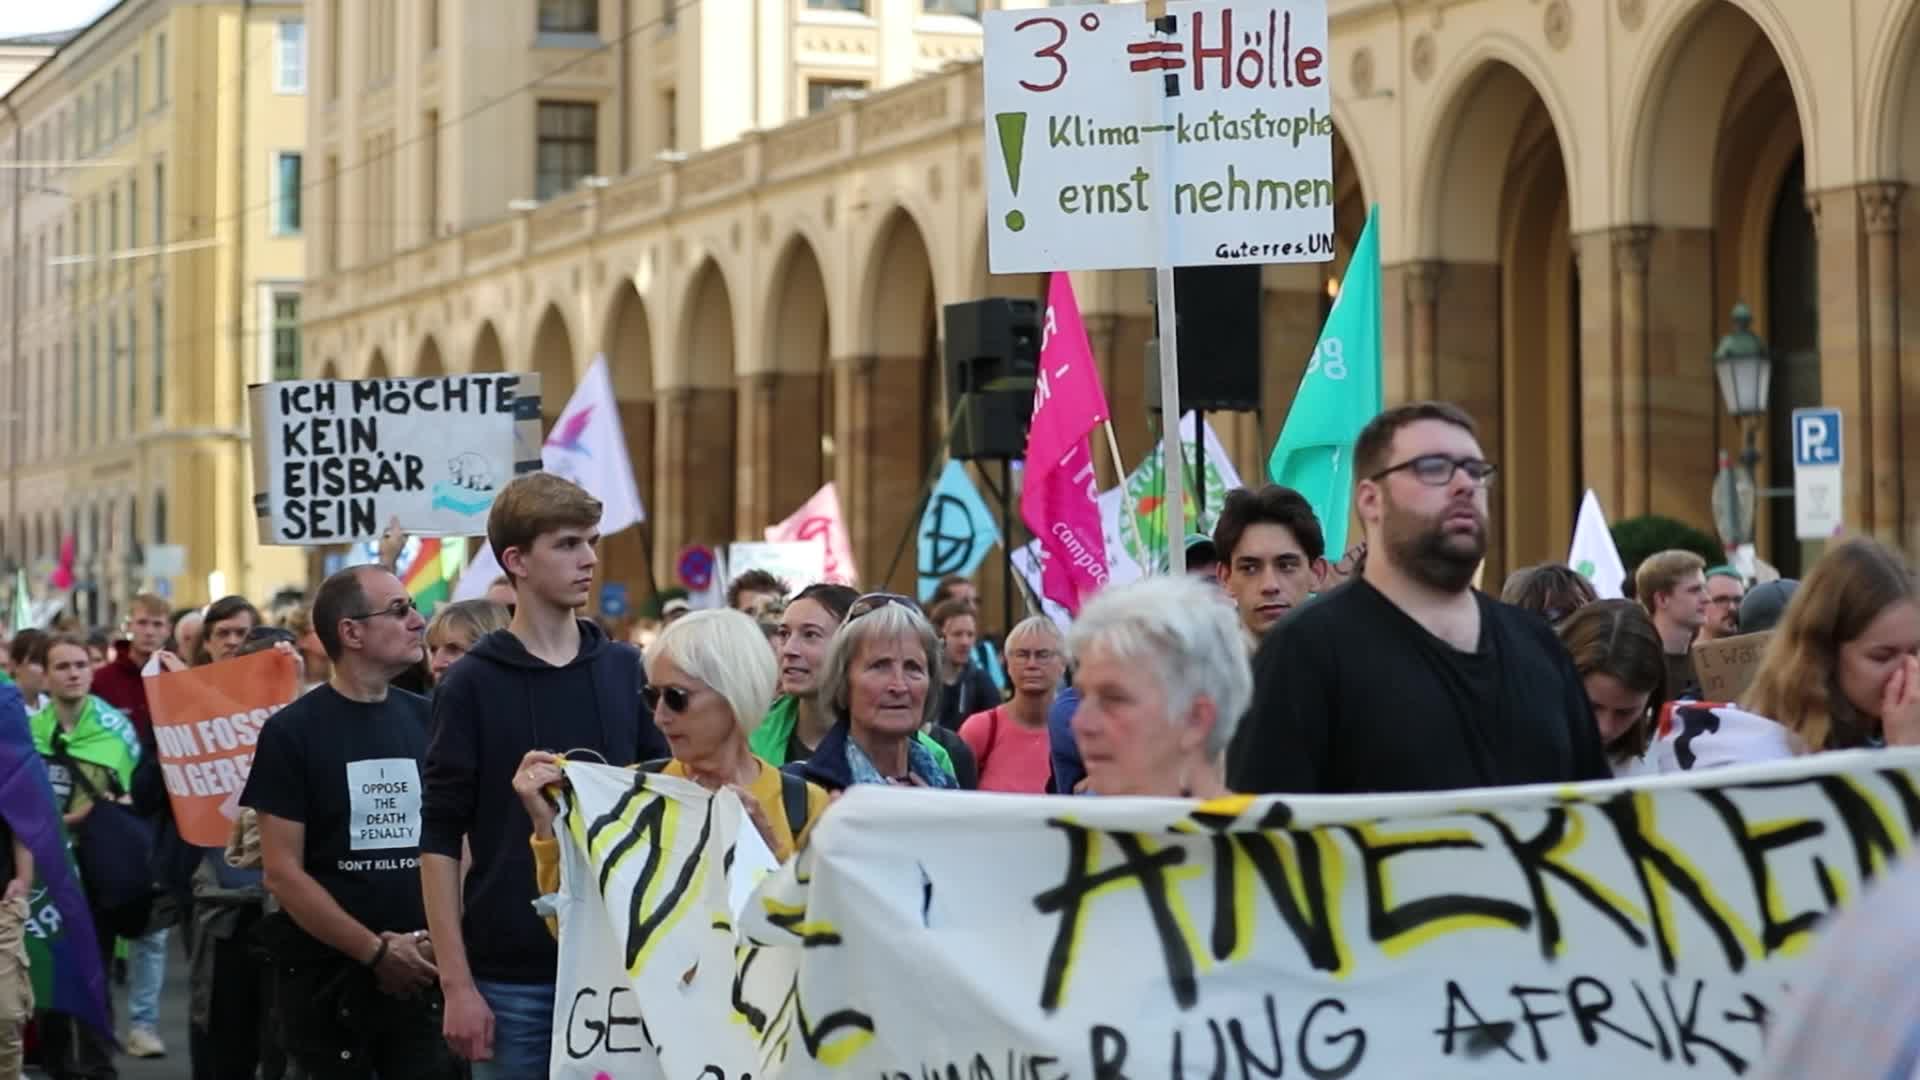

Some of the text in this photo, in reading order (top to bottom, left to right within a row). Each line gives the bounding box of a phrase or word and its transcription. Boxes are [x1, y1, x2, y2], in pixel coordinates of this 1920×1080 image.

[1192, 8, 1323, 91] Hölle
[1058, 164, 1335, 215] ernst nehmen
[280, 376, 521, 416] ICH MÖCHTE
[283, 416, 378, 457] KEIN
[283, 450, 425, 499] EISBÄR
[281, 497, 377, 540] SEIN
[362, 781, 409, 795] OPPOSE
[374, 797, 397, 810] THE
[360, 826, 415, 841] PENALTY
[366, 812, 407, 826] DEATH
[337, 859, 372, 872] DON'T
[374, 858, 398, 871] KILL
